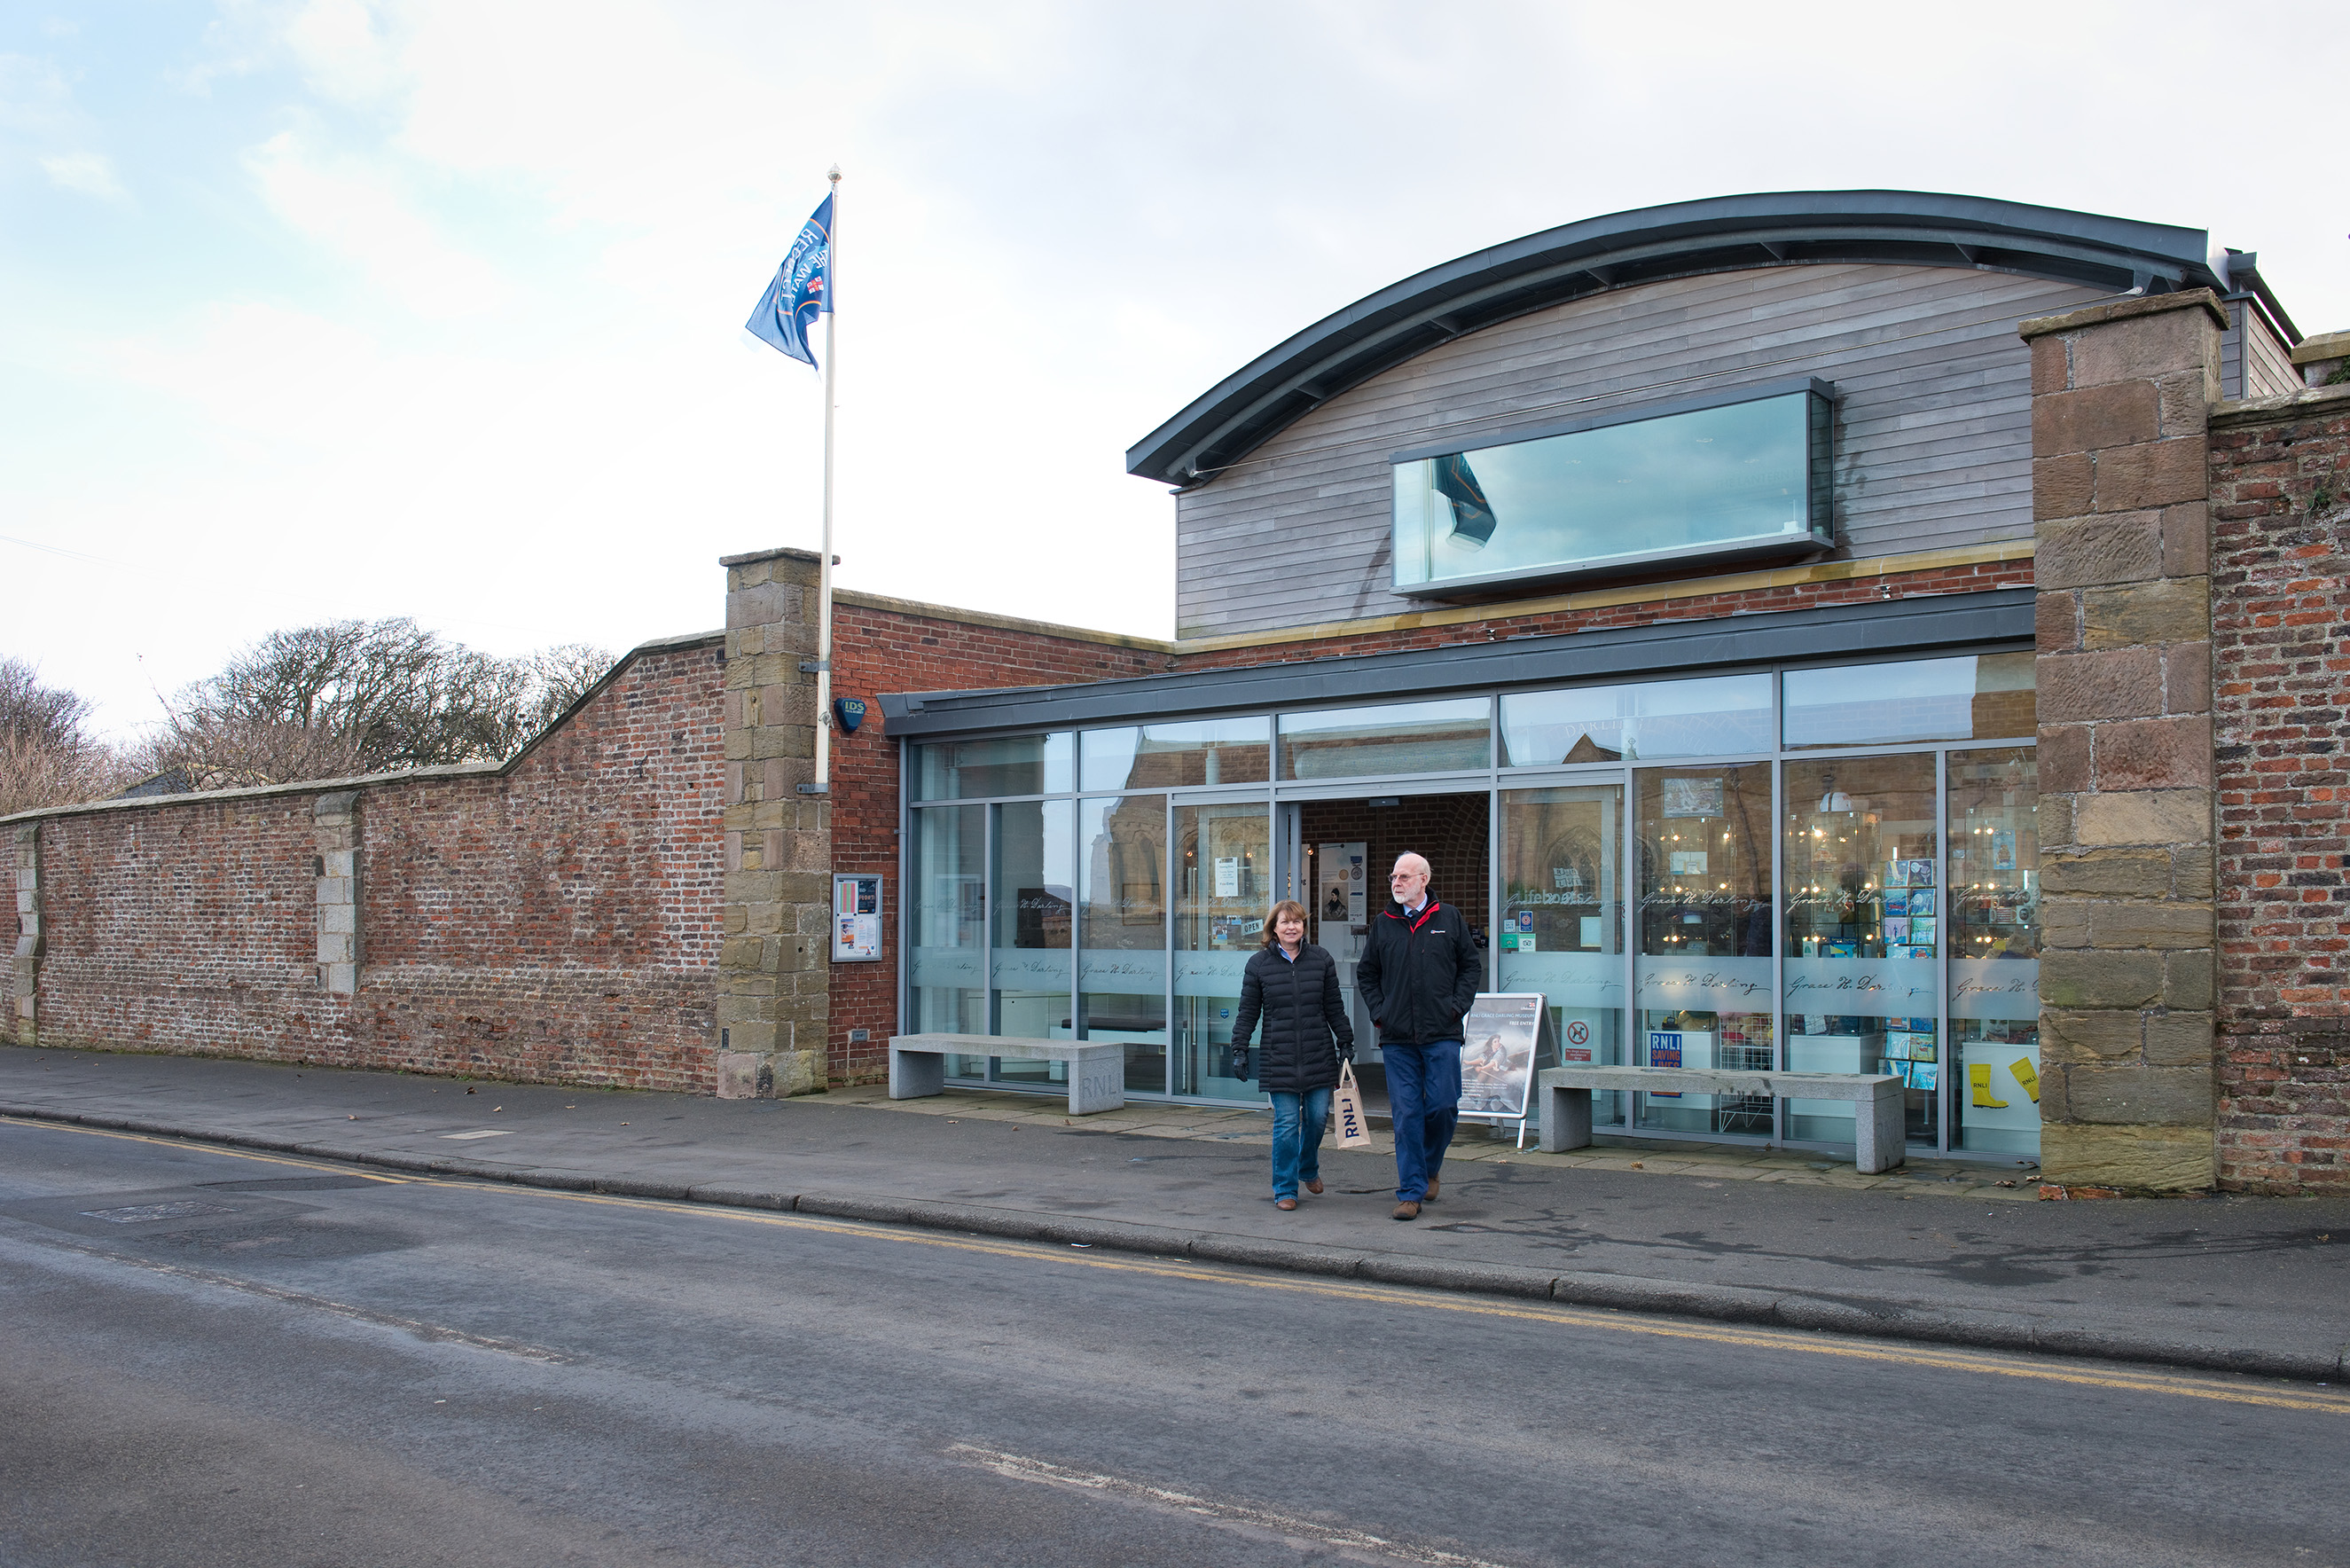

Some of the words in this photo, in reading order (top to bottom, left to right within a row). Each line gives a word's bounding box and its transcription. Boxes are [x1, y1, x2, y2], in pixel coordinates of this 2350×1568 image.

[844, 701, 865, 711] IDS
[1564, 718, 1642, 739] DARLI
[1244, 921, 1260, 933] OPEN
[1176, 964, 1204, 983] Gace
[1652, 1035, 1680, 1050] RNLI
[1652, 1049, 1680, 1061] SAVING
[1082, 1072, 1121, 1099] RNLI
[2021, 1075, 2037, 1086] RNLI
[1341, 1098, 1360, 1139] RNLI
